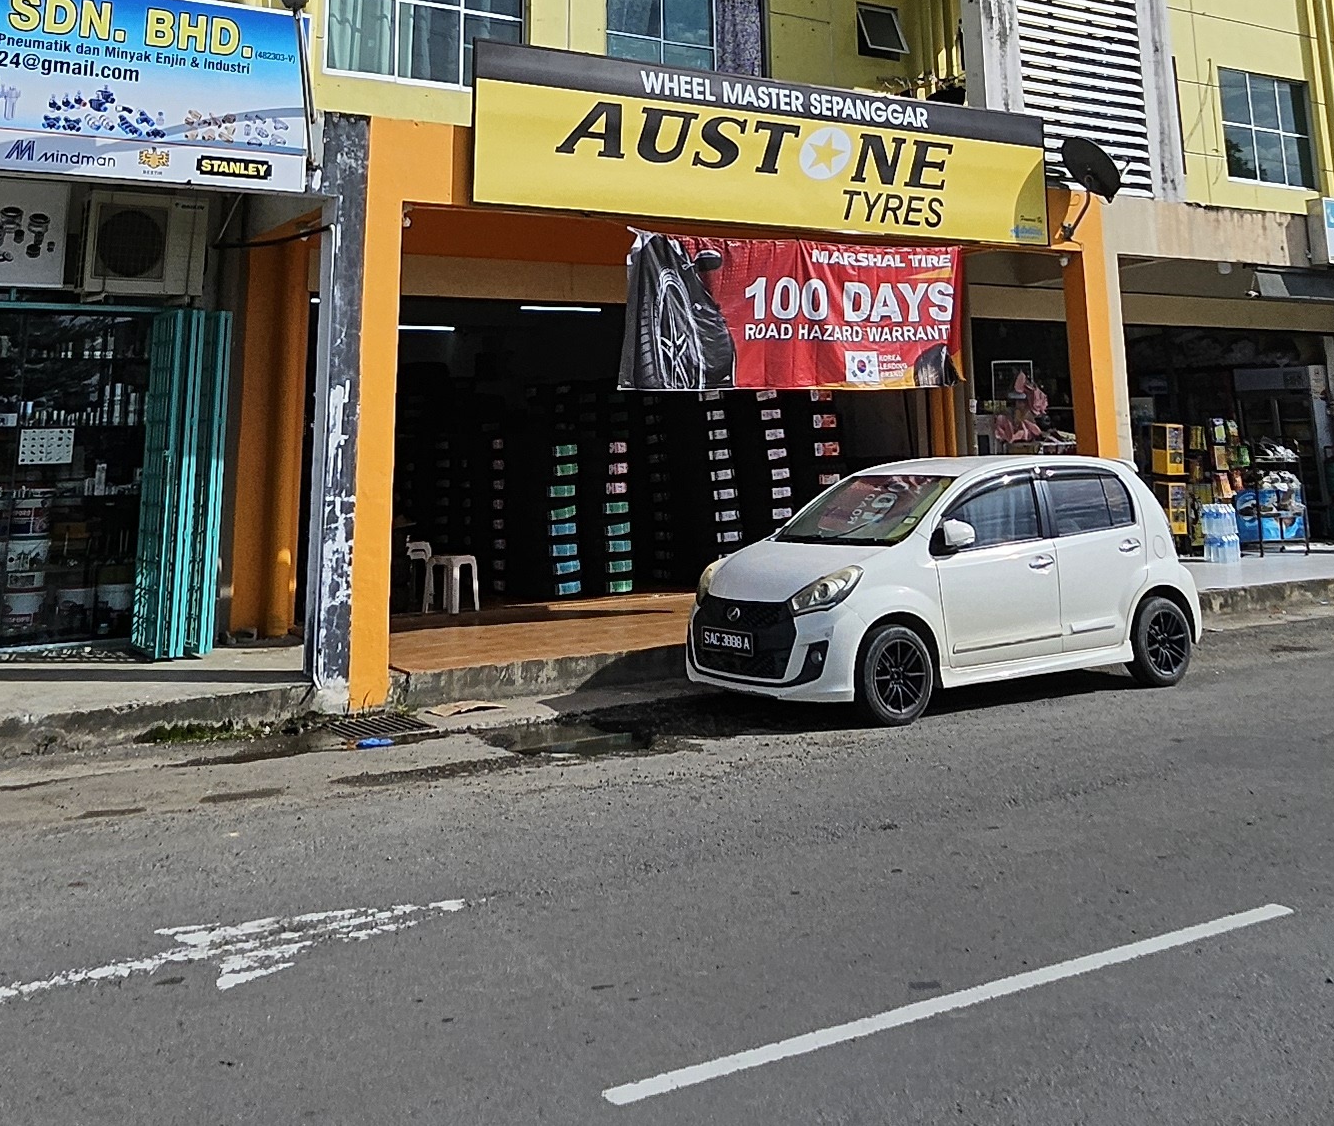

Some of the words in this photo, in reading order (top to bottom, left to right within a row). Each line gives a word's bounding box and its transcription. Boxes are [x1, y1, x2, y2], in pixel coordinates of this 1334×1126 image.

[144, 7, 253, 60] BHD.
[254, 50, 296, 66] (482303-V)
[75, 42, 101, 58] dan
[104, 45, 152, 65] Minyak
[155, 52, 188, 70] Enjin
[190, 57, 201, 69] &
[203, 58, 251, 75] Industri
[640, 70, 718, 102] WHEEL
[722, 84, 804, 115] MASTER
[809, 94, 929, 130] SEPANGGAR
[200, 158, 269, 177] STANLEY
[841, 189, 946, 229] TYRES
[811, 249, 905, 268] MARSHAL
[907, 254, 951, 268] TIRE
[744, 276, 829, 321] 100
[842, 281, 955, 323] DAYS
[745, 324, 793, 341] ROAD
[798, 324, 863, 342] HAZARD
[867, 324, 951, 342] WARRANT
[704, 631, 721, 646] SAC
[743, 637, 751, 651] A
